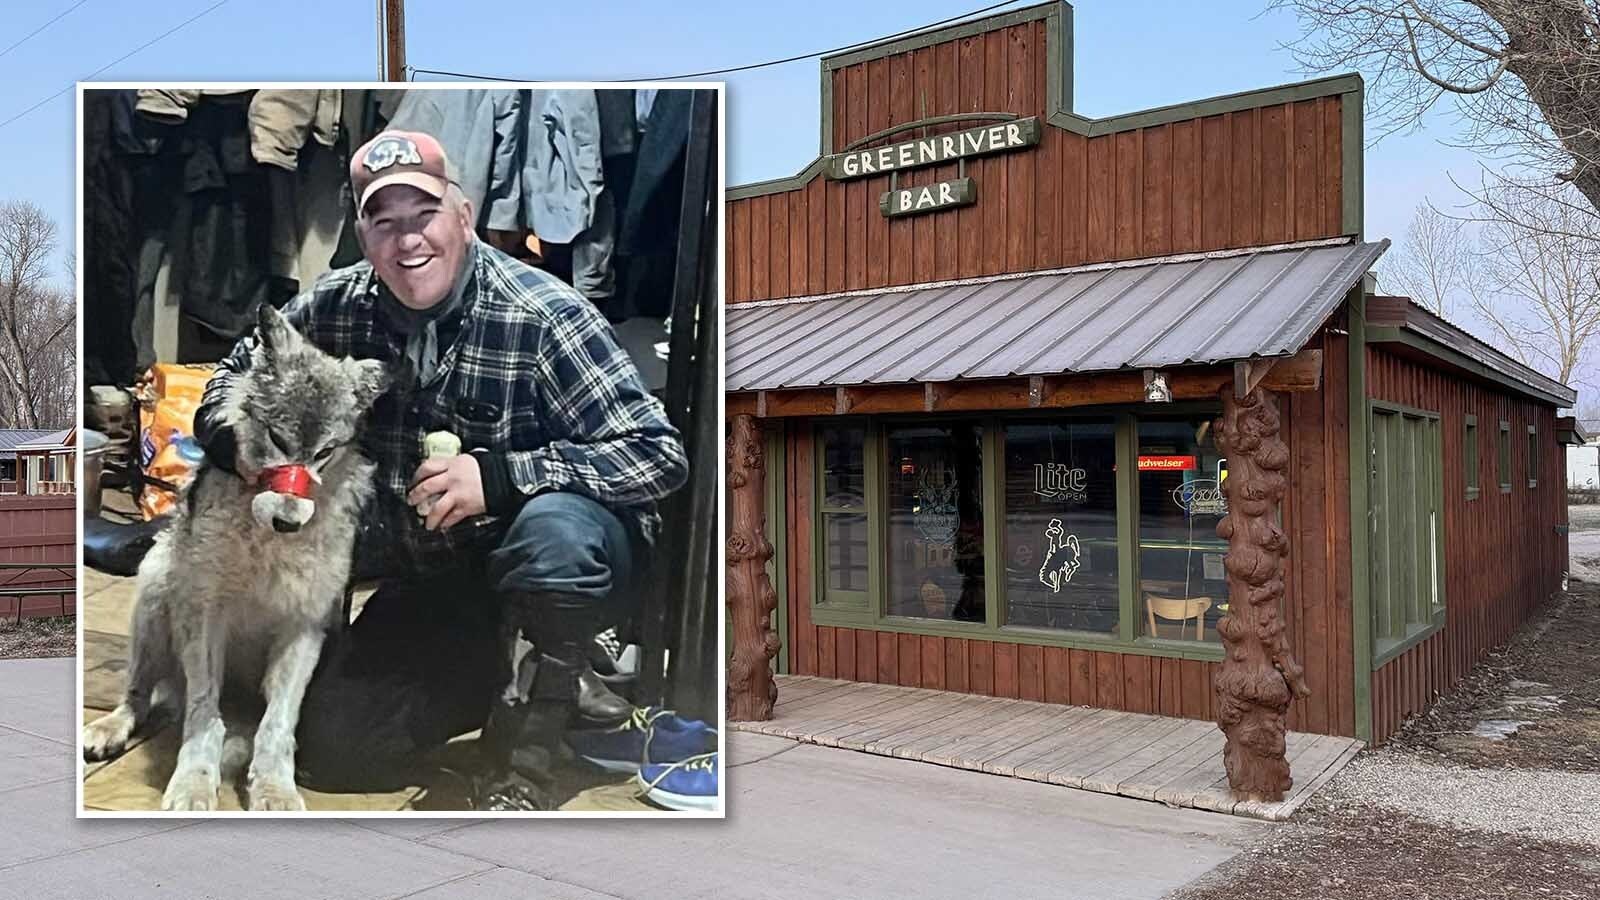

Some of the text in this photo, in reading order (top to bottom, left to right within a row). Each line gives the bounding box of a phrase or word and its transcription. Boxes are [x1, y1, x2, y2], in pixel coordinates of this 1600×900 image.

[843, 124, 1023, 176] GREENRIVER
[900, 183, 954, 211] BAR
[1138, 459, 1184, 467] udweiser
[1033, 463, 1087, 497] Lite
[1057, 492, 1087, 502] OPEN
